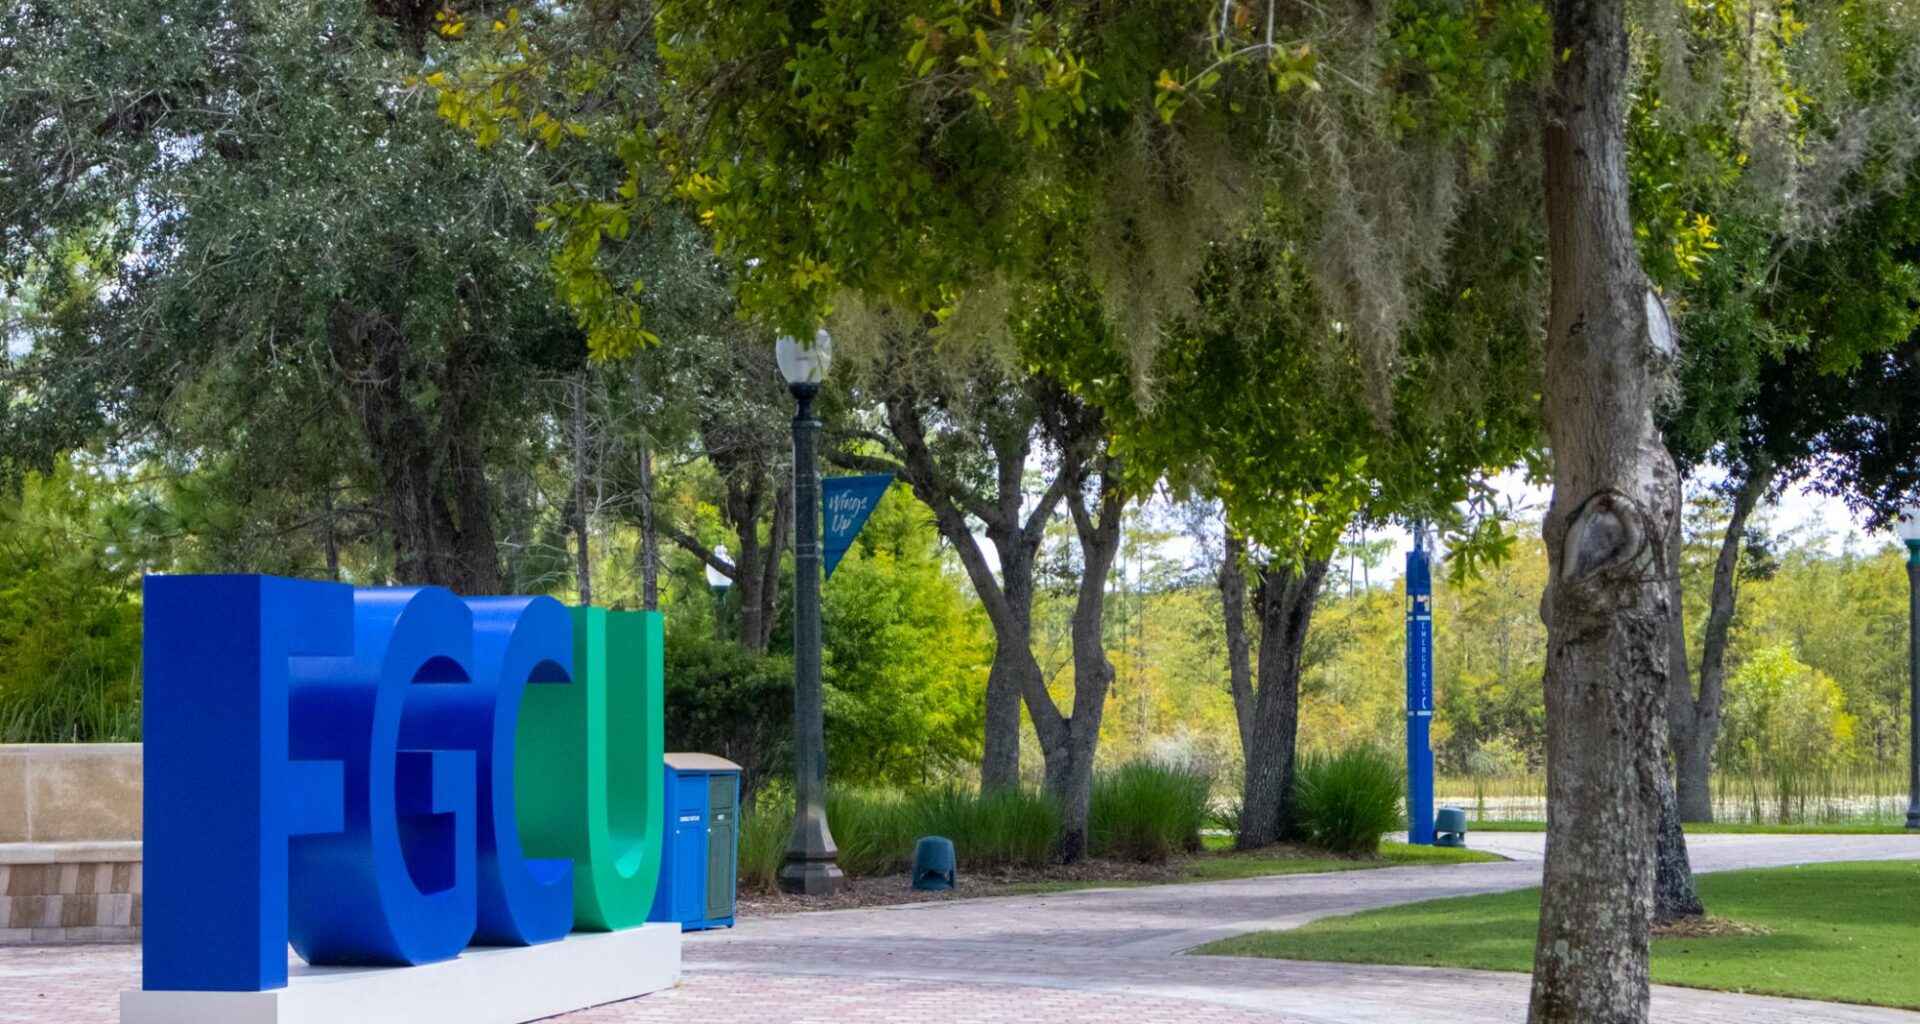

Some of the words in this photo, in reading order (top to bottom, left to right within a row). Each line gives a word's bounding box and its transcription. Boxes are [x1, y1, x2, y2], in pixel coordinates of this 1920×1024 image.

[829, 489, 868, 518] Wings
[832, 514, 851, 537] Up
[142, 574, 664, 992] FGCU
